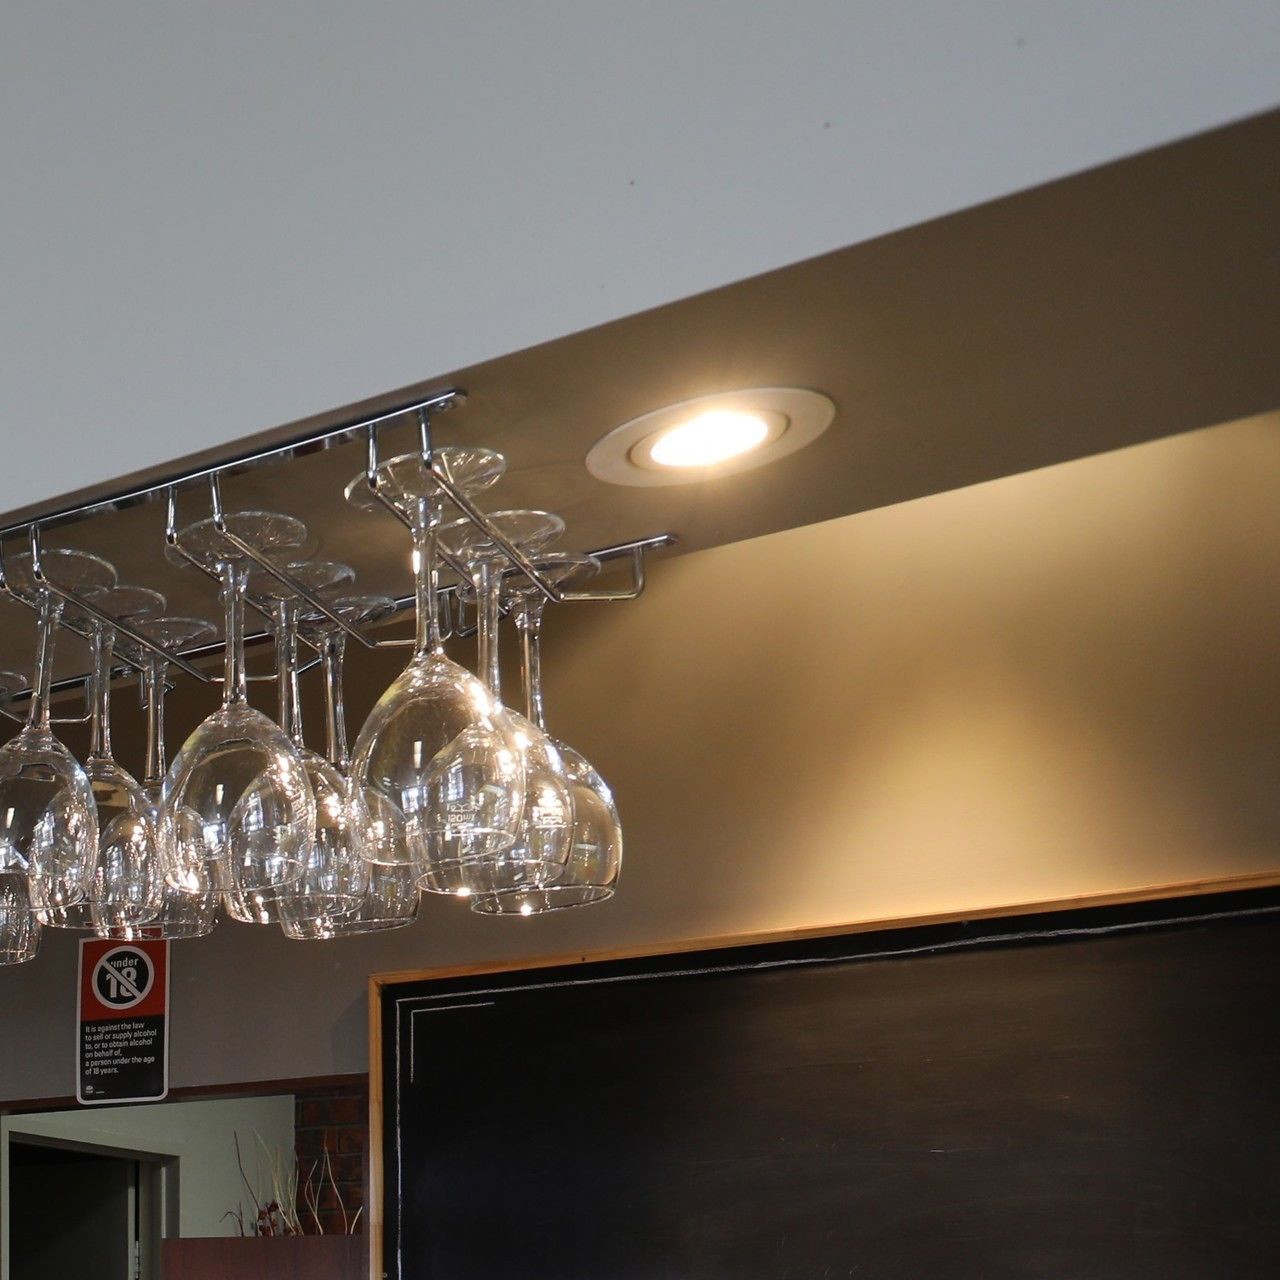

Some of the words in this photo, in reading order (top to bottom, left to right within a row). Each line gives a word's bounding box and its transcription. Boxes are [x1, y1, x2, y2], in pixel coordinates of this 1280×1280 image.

[105, 966, 138, 999] 18
[97, 1023, 120, 1033] against
[120, 1022, 132, 1030] the
[132, 1021, 145, 1029] law
[93, 1033, 104, 1041] sell
[112, 1030, 133, 1041] supply
[133, 1028, 157, 1038] alcohol
[109, 1040, 129, 1048] obtain
[129, 1038, 153, 1047] alcohol
[94, 1049, 113, 1058] behalf
[90, 1059, 112, 1068] person
[112, 1057, 131, 1065] under
[131, 1056, 142, 1064] the
[143, 1056, 155, 1064] age
[85, 1067, 92, 1075] of
[93, 1067, 100, 1075] 18
